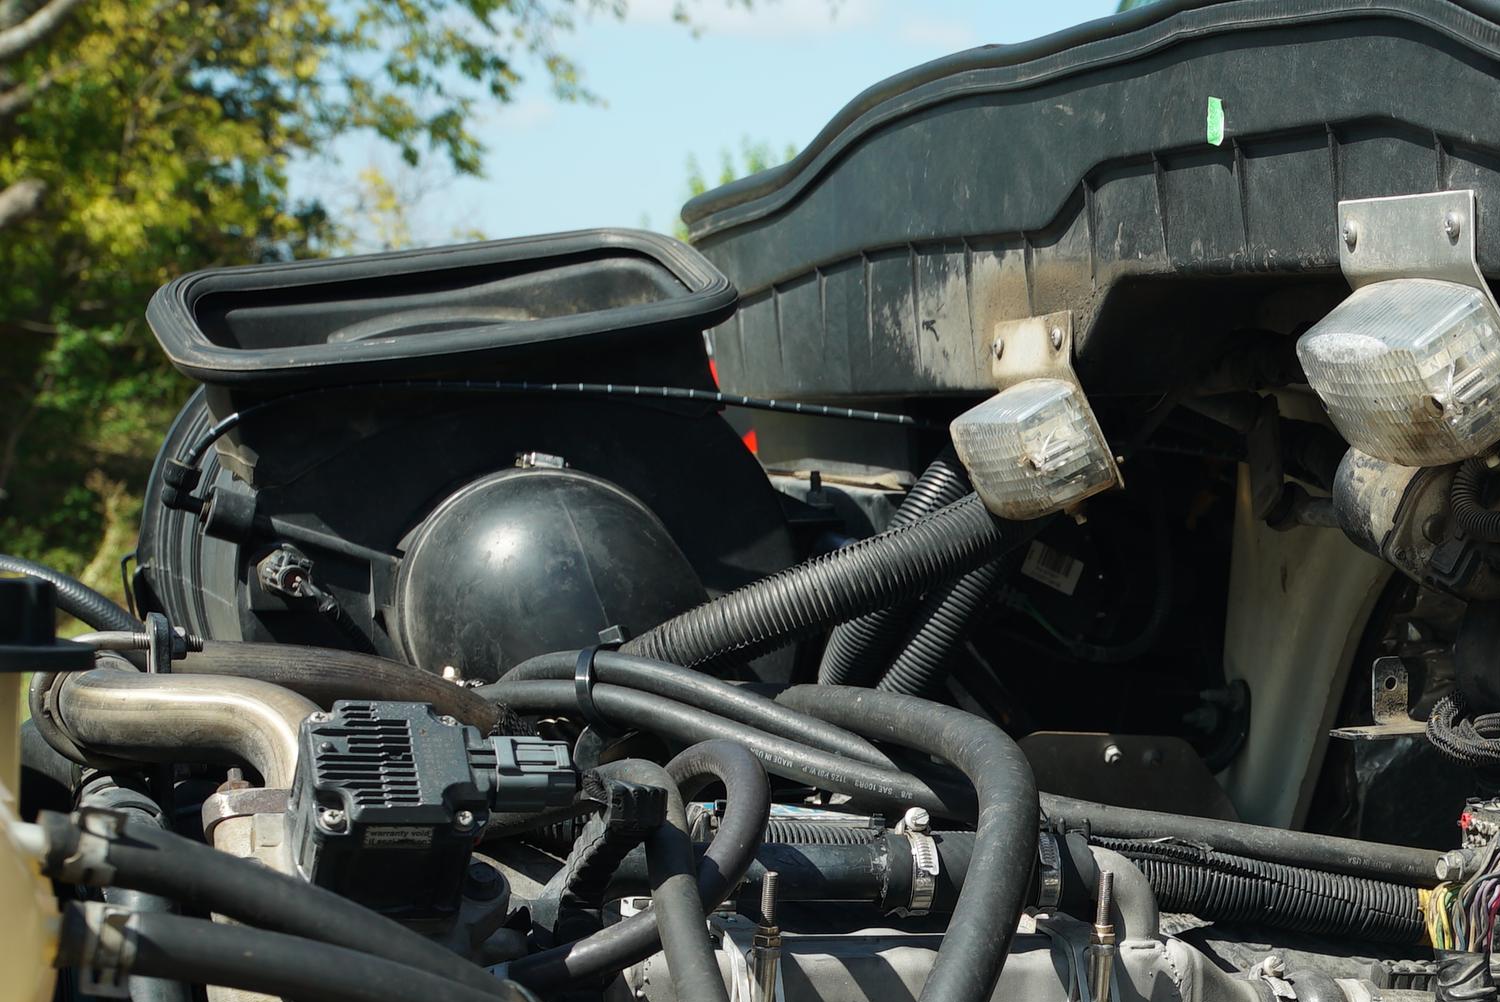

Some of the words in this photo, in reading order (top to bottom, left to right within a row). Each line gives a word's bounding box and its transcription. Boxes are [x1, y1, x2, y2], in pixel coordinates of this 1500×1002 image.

[764, 753, 773, 762] IN
[773, 756, 793, 768] MADE
[878, 785, 893, 795] SAE
